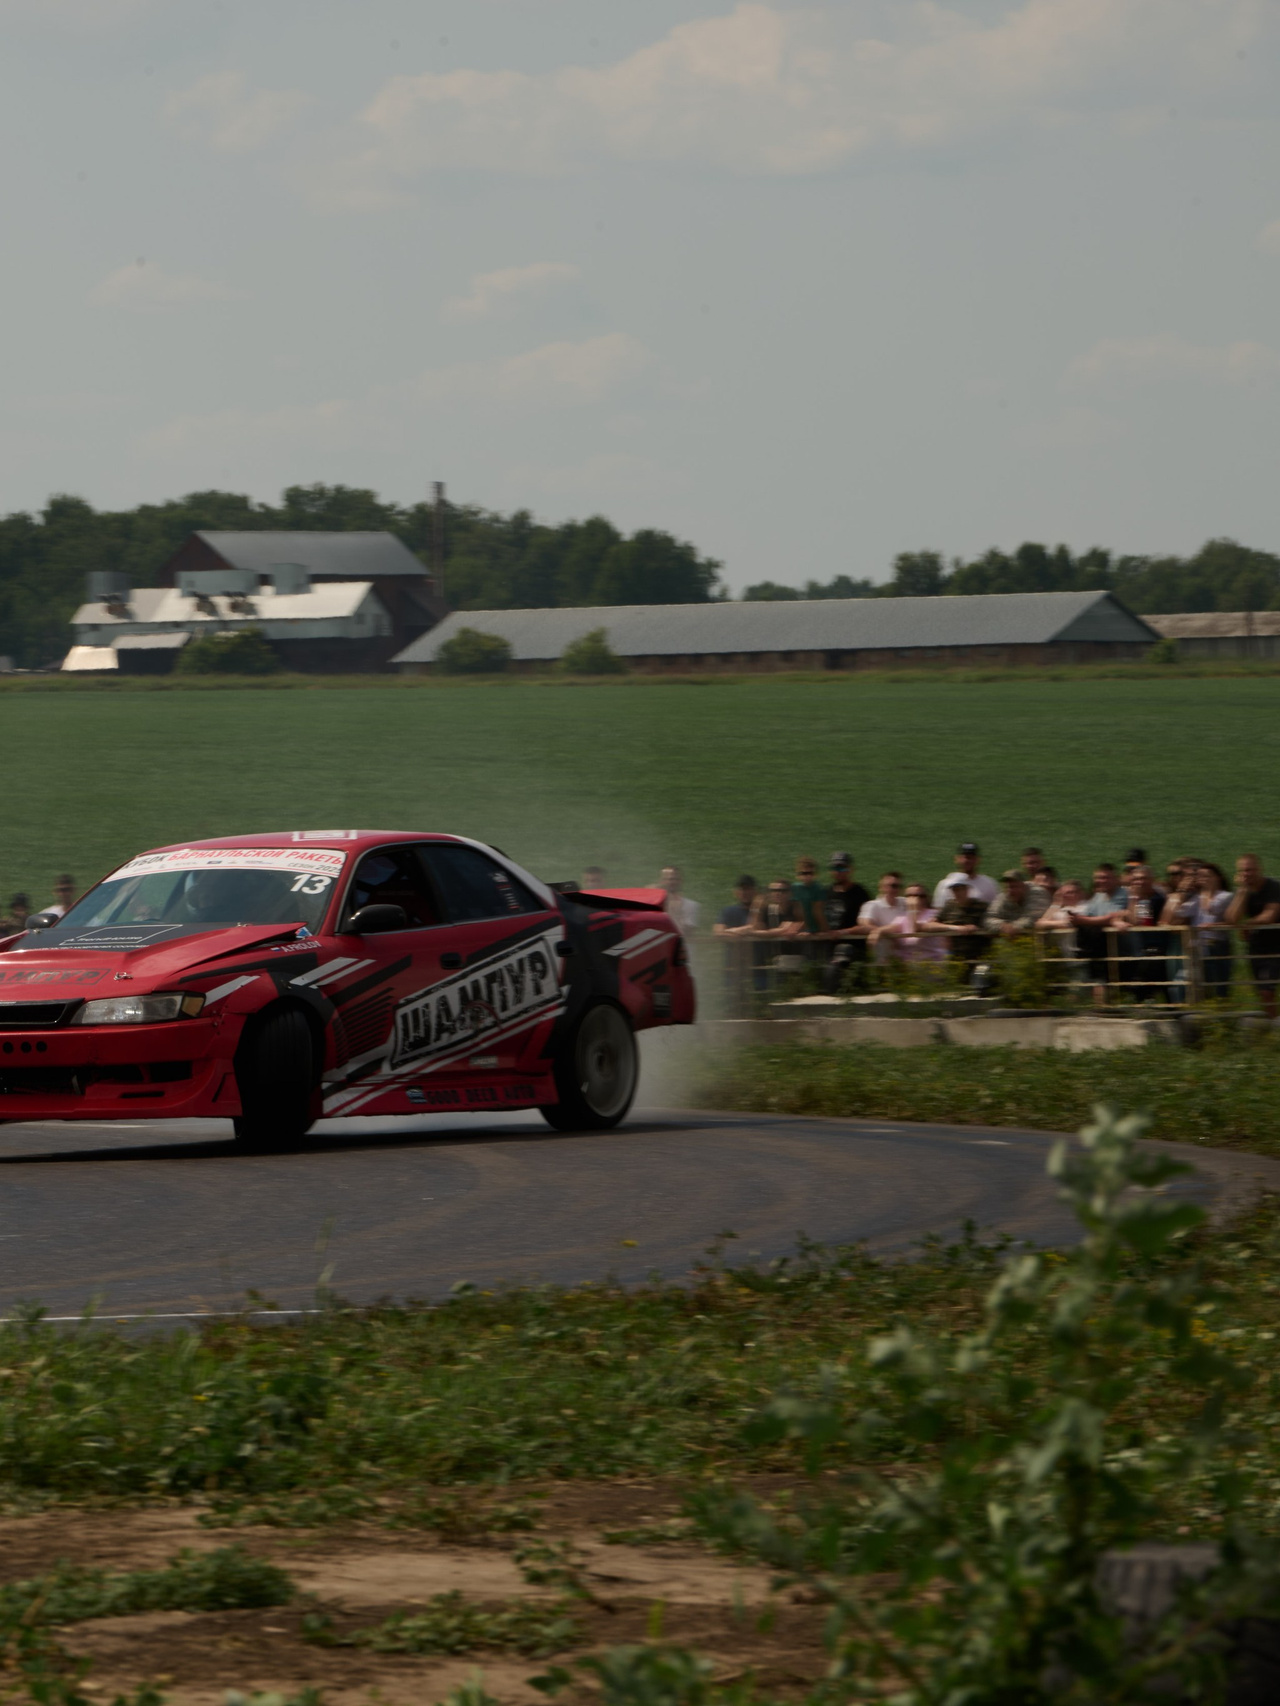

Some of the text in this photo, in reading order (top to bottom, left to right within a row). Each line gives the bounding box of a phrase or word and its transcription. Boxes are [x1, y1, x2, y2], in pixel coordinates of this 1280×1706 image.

[168, 849, 283, 861] БАРНАУЛЬСКОЙ
[290, 873, 332, 895] 13
[400, 951, 547, 1055] ШАМПУР
